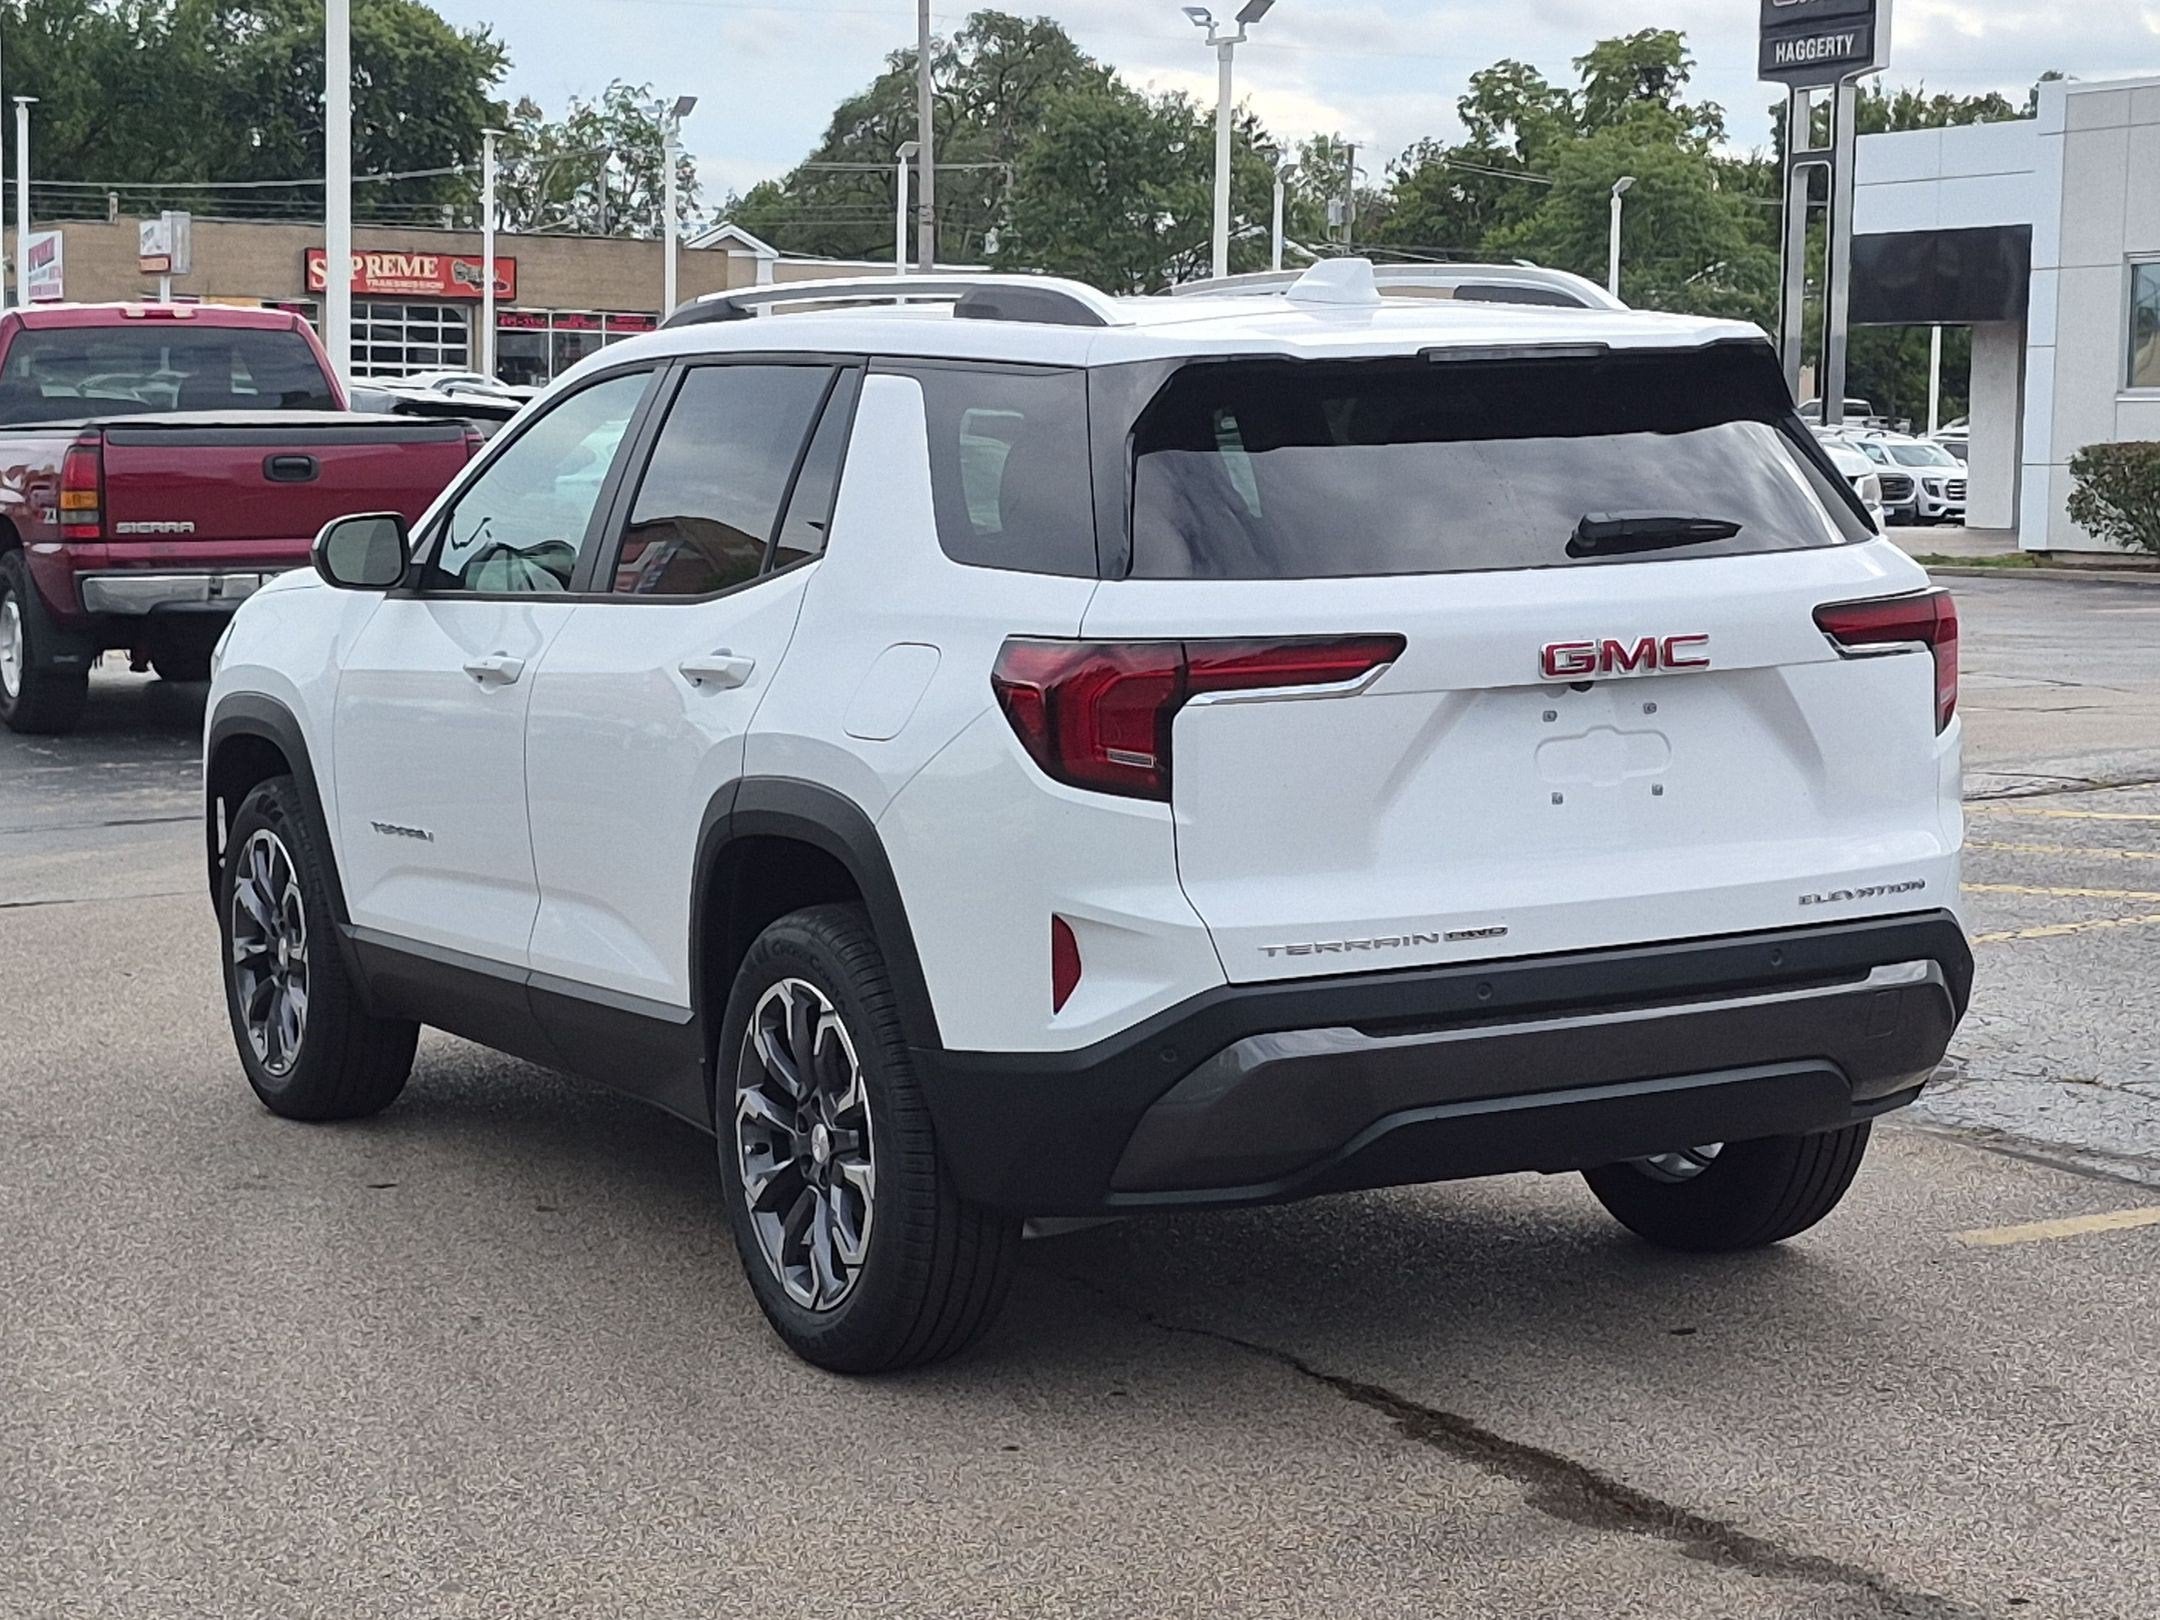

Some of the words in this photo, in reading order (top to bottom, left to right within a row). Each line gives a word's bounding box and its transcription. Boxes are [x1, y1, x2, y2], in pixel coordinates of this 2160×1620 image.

[1775, 33, 1854, 63] HAGGERTY
[310, 253, 439, 288] SPREME
[116, 521, 195, 533] SIERRA
[1540, 633, 1710, 680] GMC
[1799, 878, 1925, 905] ELEVATION
[1258, 932, 1440, 957] TERRAIN
